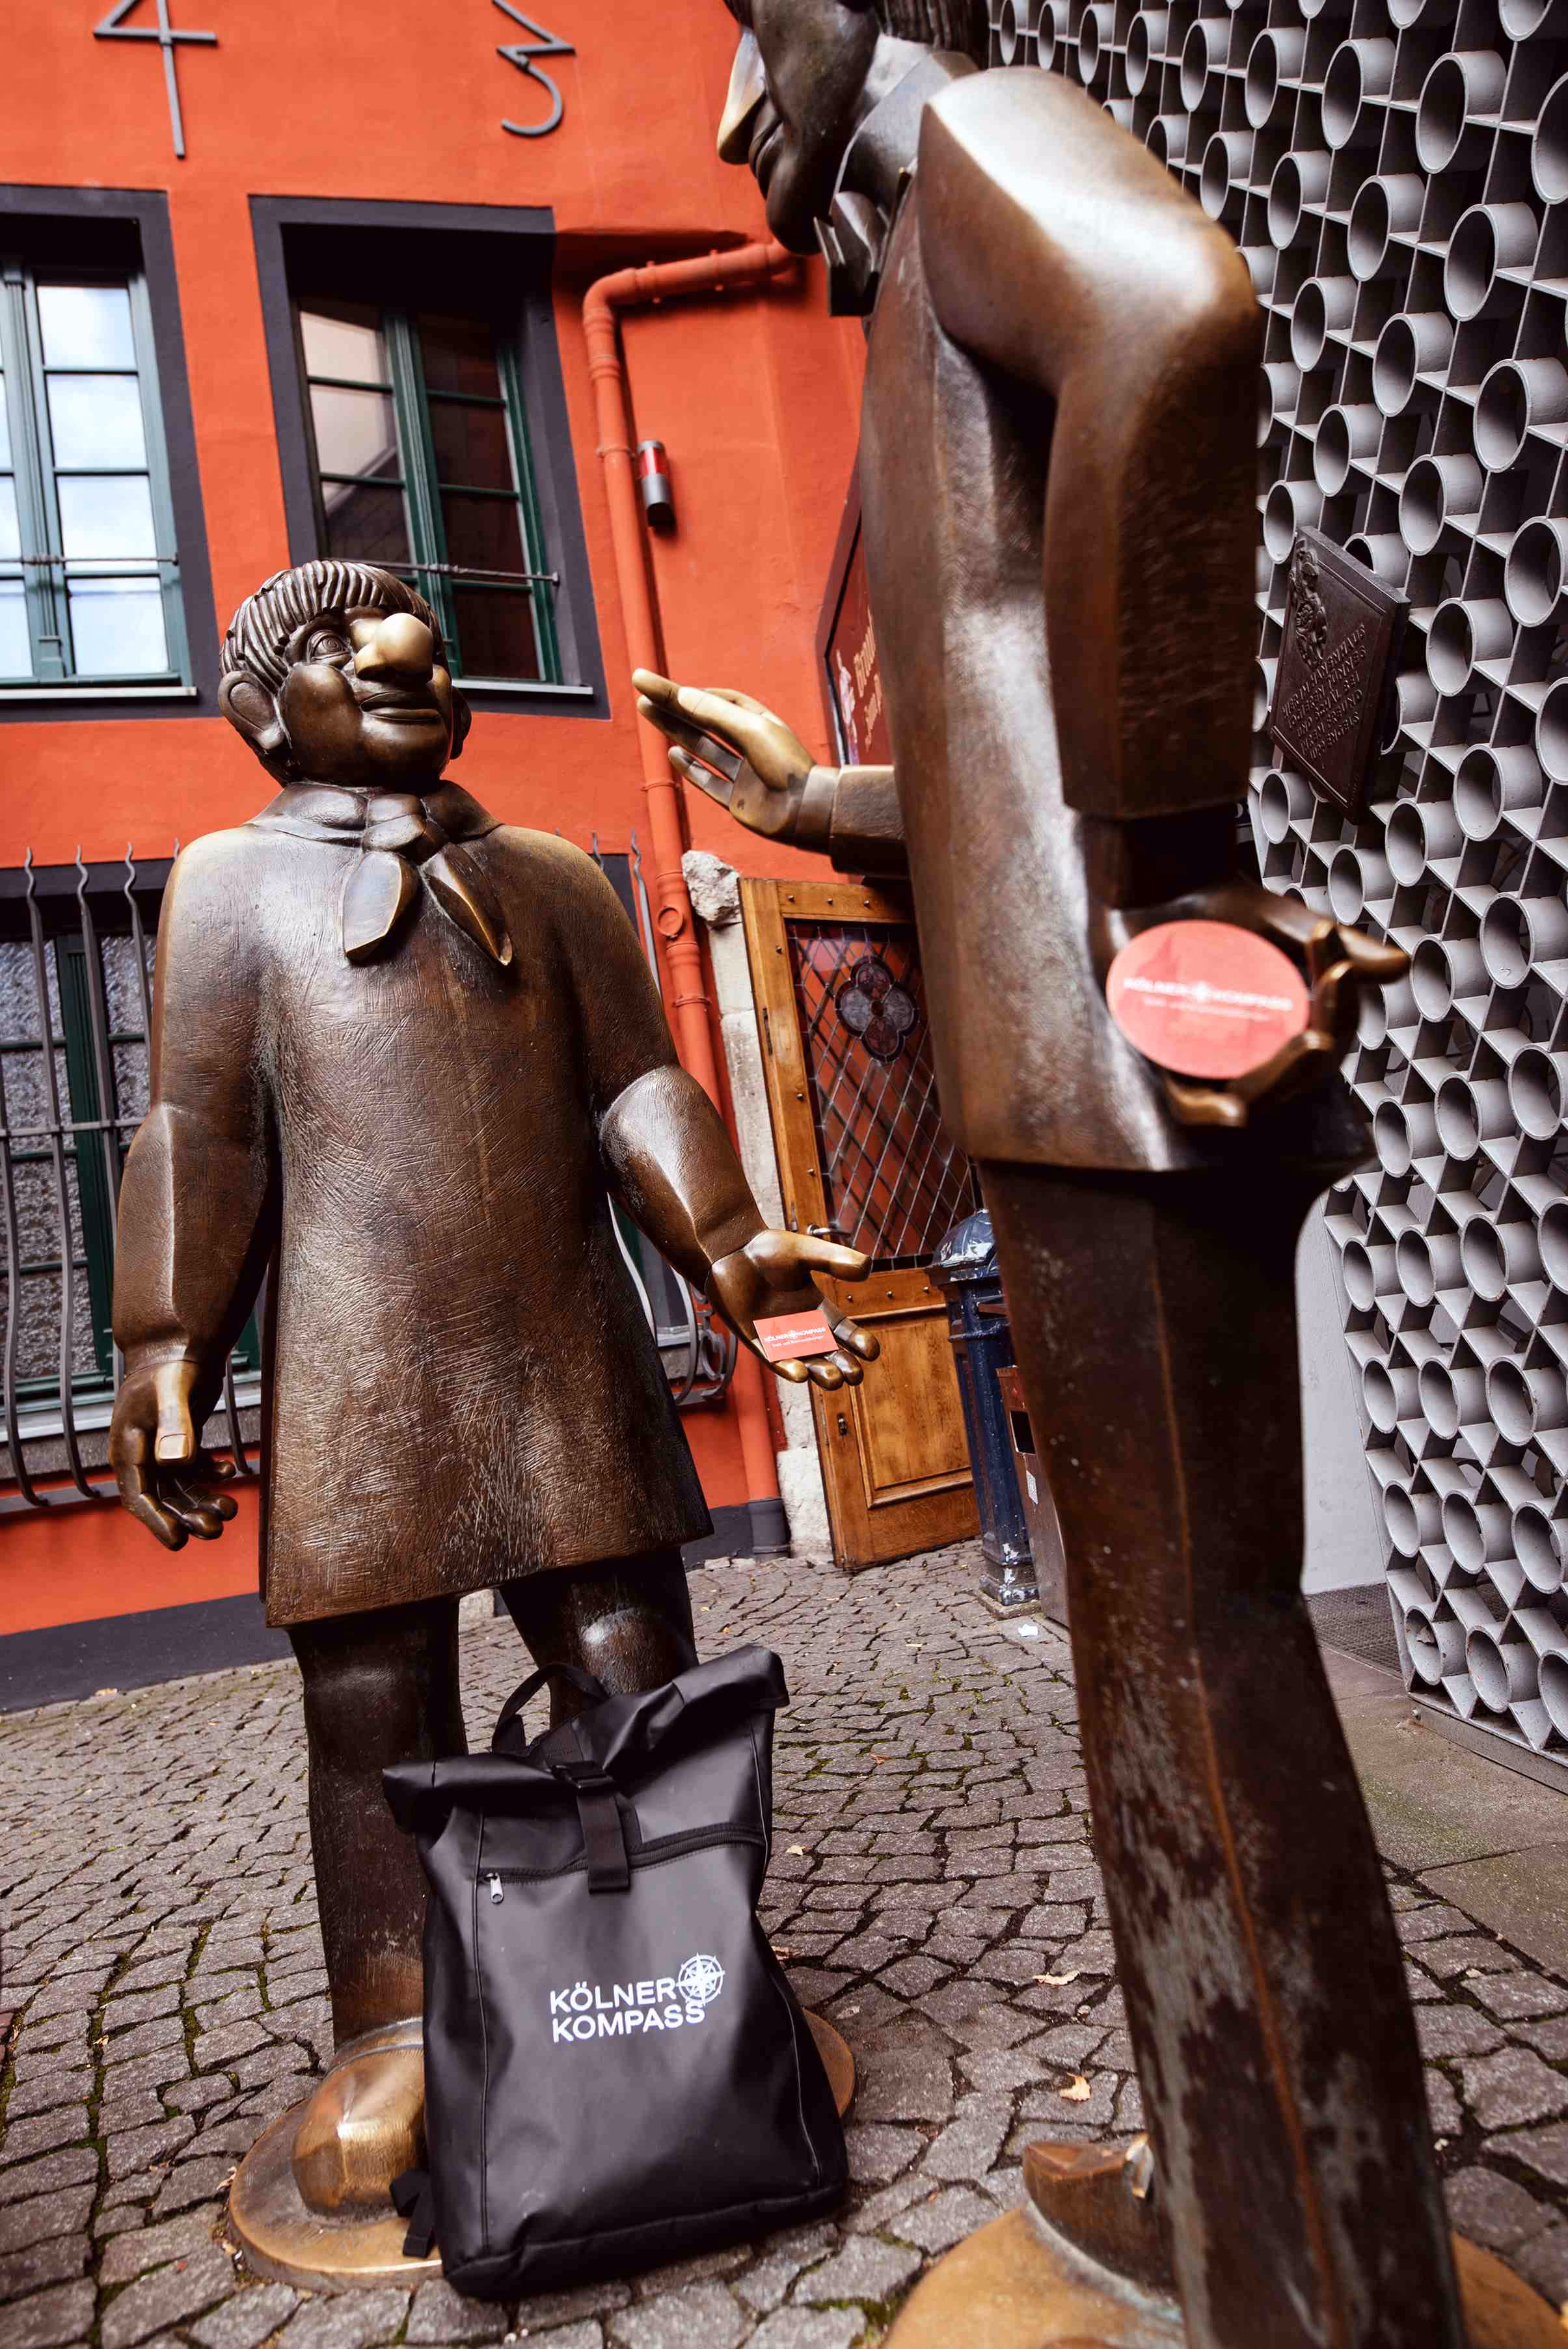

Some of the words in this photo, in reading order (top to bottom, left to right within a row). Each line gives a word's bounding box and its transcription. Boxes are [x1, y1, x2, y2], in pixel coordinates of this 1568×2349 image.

[93, 0, 217, 158] 4
[492, 0, 575, 137] 3
[550, 1977, 677, 2015] KÖLNER
[552, 2001, 705, 2043] KOMPASS
